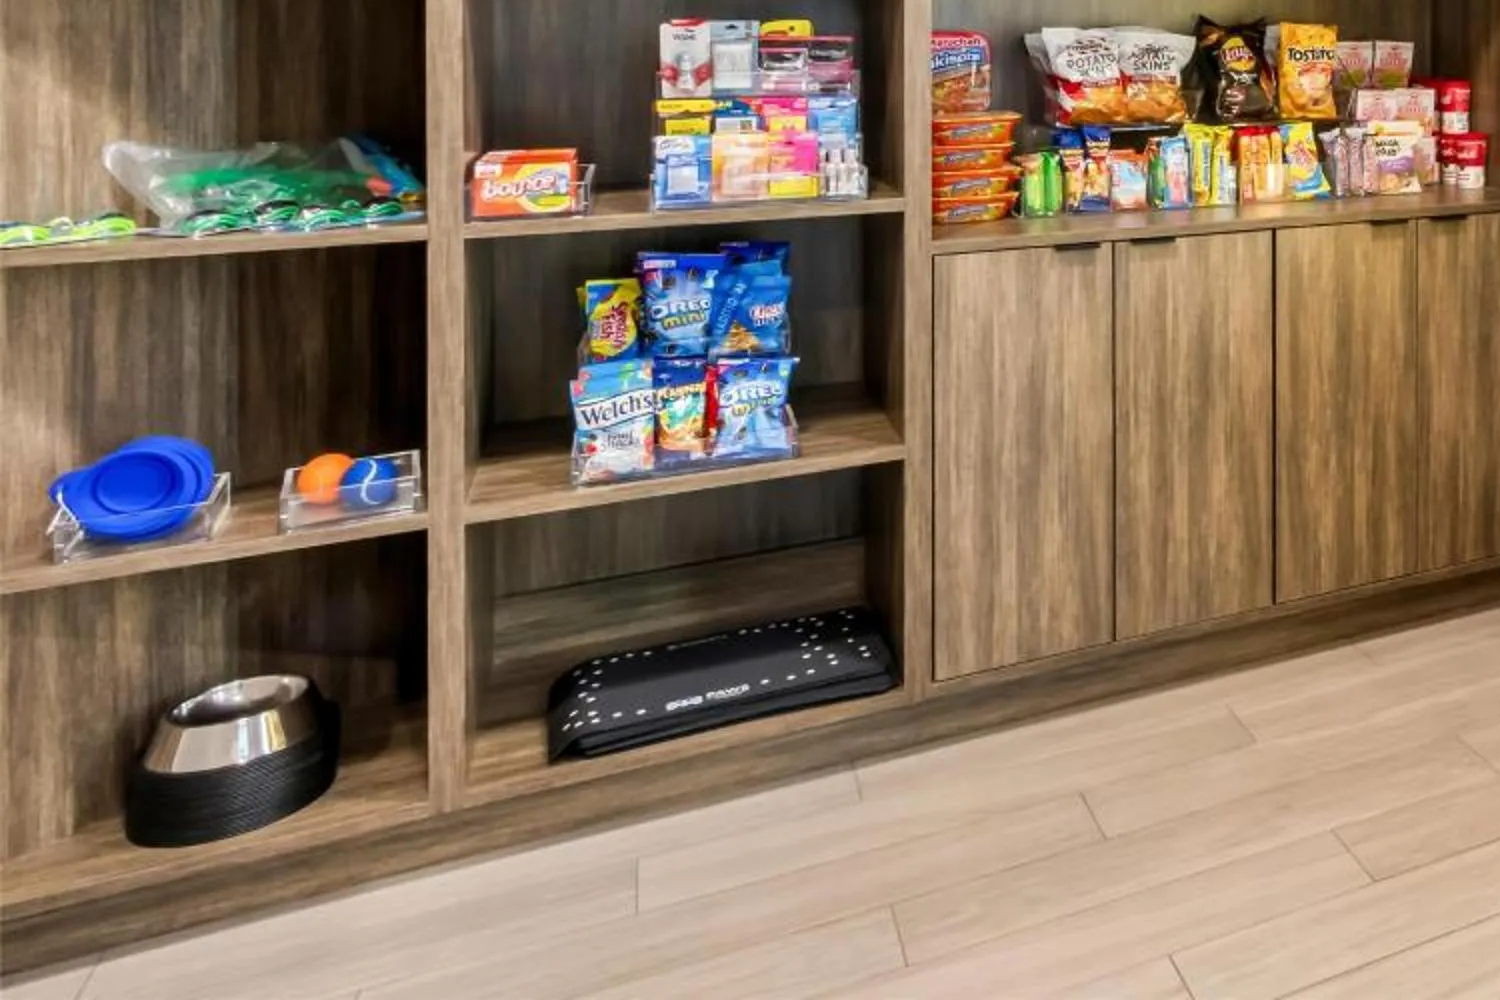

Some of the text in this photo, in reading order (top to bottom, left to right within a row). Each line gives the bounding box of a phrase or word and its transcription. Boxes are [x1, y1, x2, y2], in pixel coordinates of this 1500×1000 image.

[930, 37, 982, 50] aruchan
[650, 299, 711, 319] OREO
[580, 390, 656, 426] Welch's
